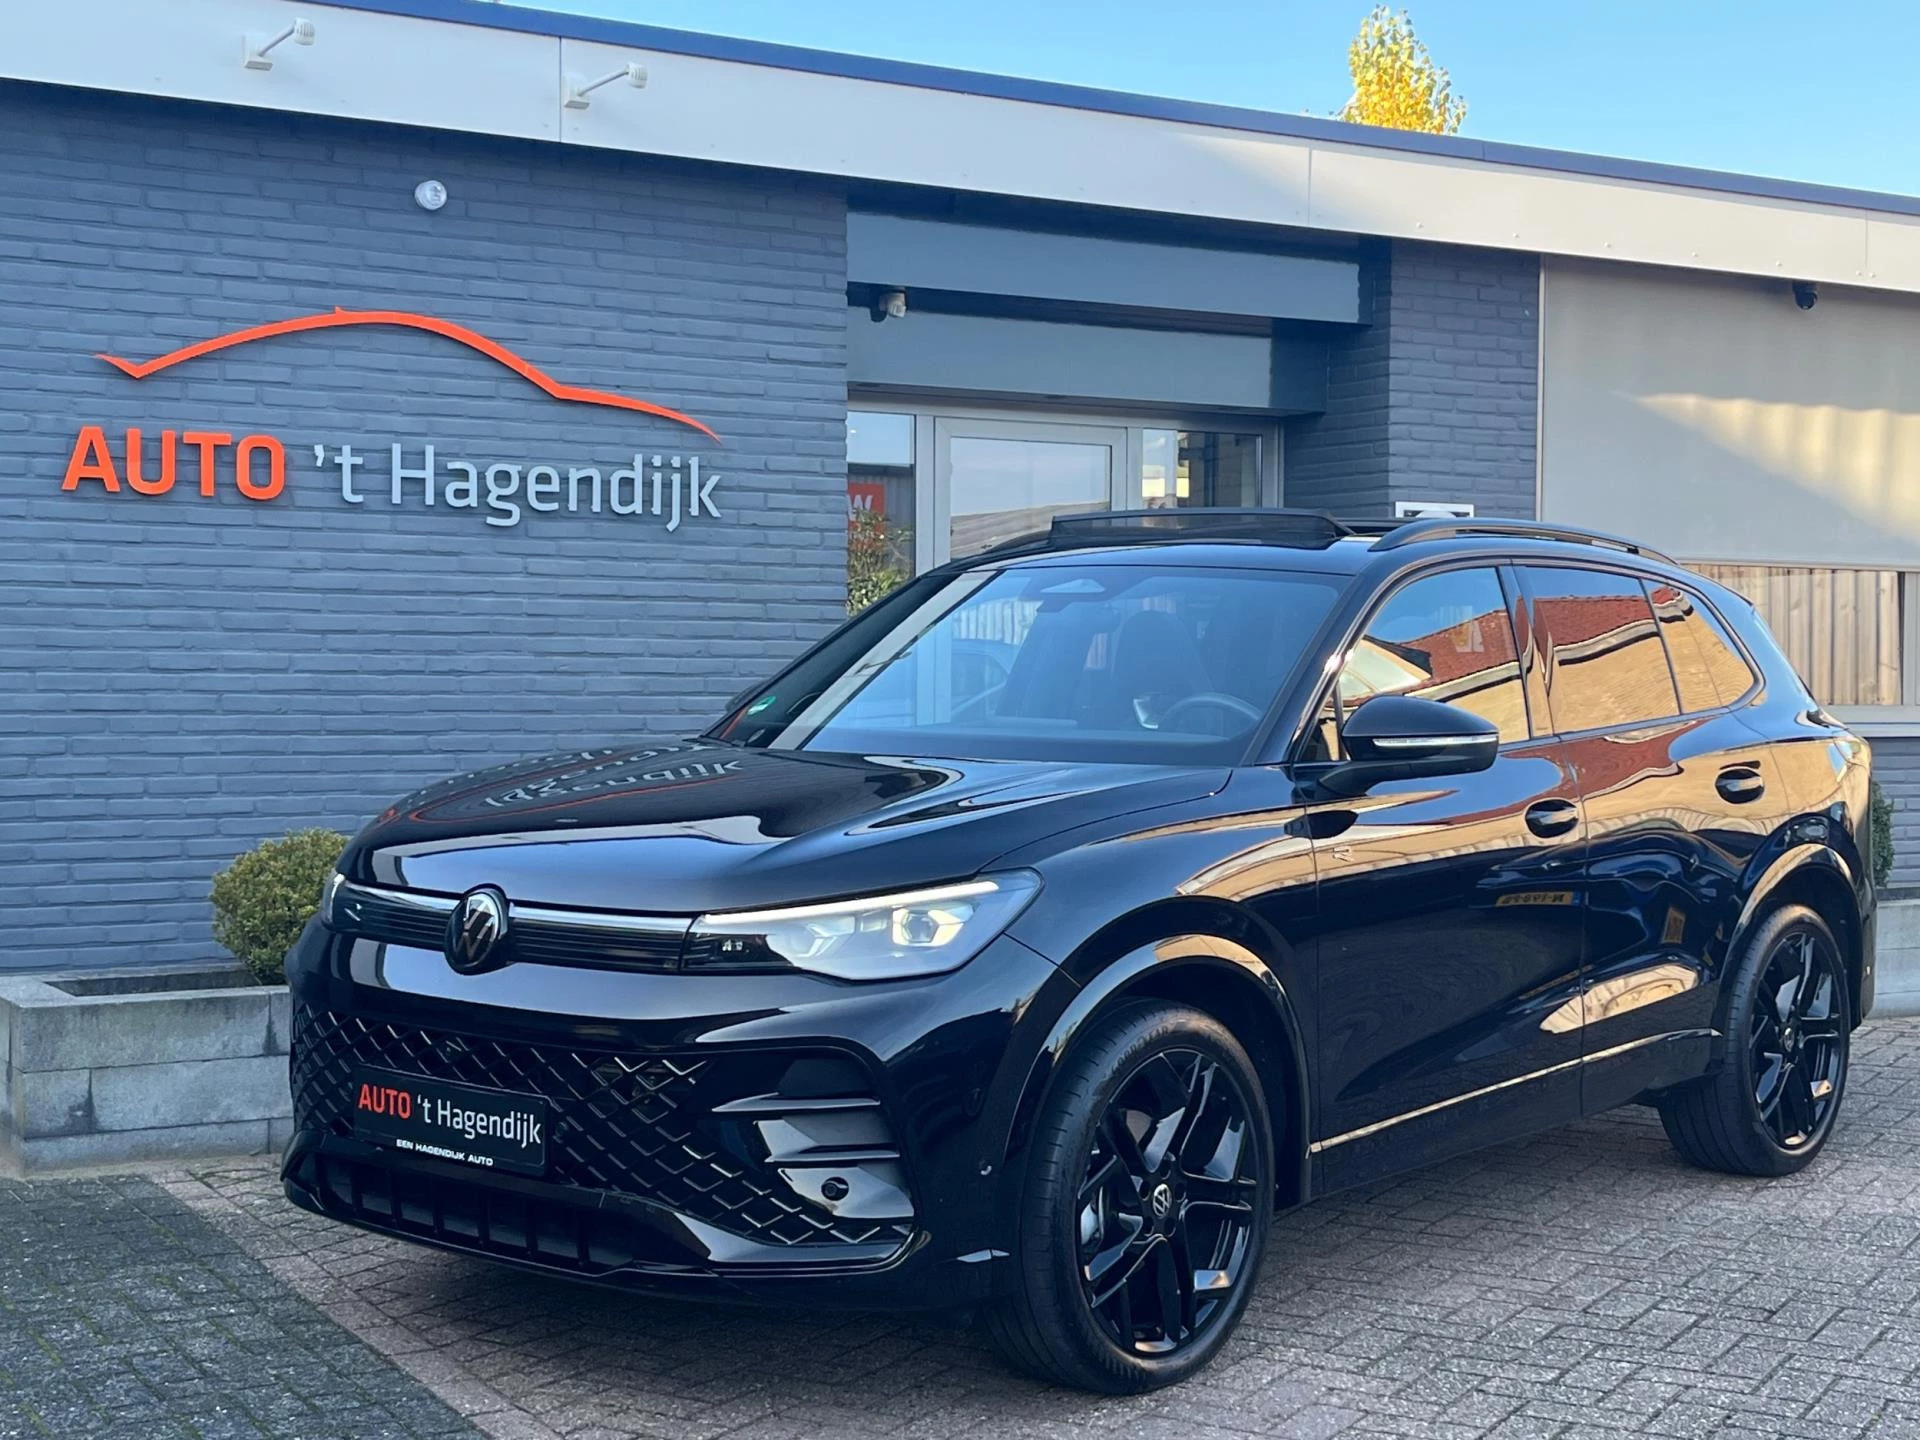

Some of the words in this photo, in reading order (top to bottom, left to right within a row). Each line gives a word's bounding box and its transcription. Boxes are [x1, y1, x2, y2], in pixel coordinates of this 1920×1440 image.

[61, 425, 285, 500] AUTO
[313, 443, 363, 503] 't
[391, 443, 722, 532] Hagendijk
[358, 1083, 411, 1119] AUTO
[437, 1099, 542, 1148] Hagendijk
[396, 1138, 414, 1150] EEN
[415, 1143, 465, 1161] HAGENDIJK
[467, 1154, 494, 1166] AUTO
